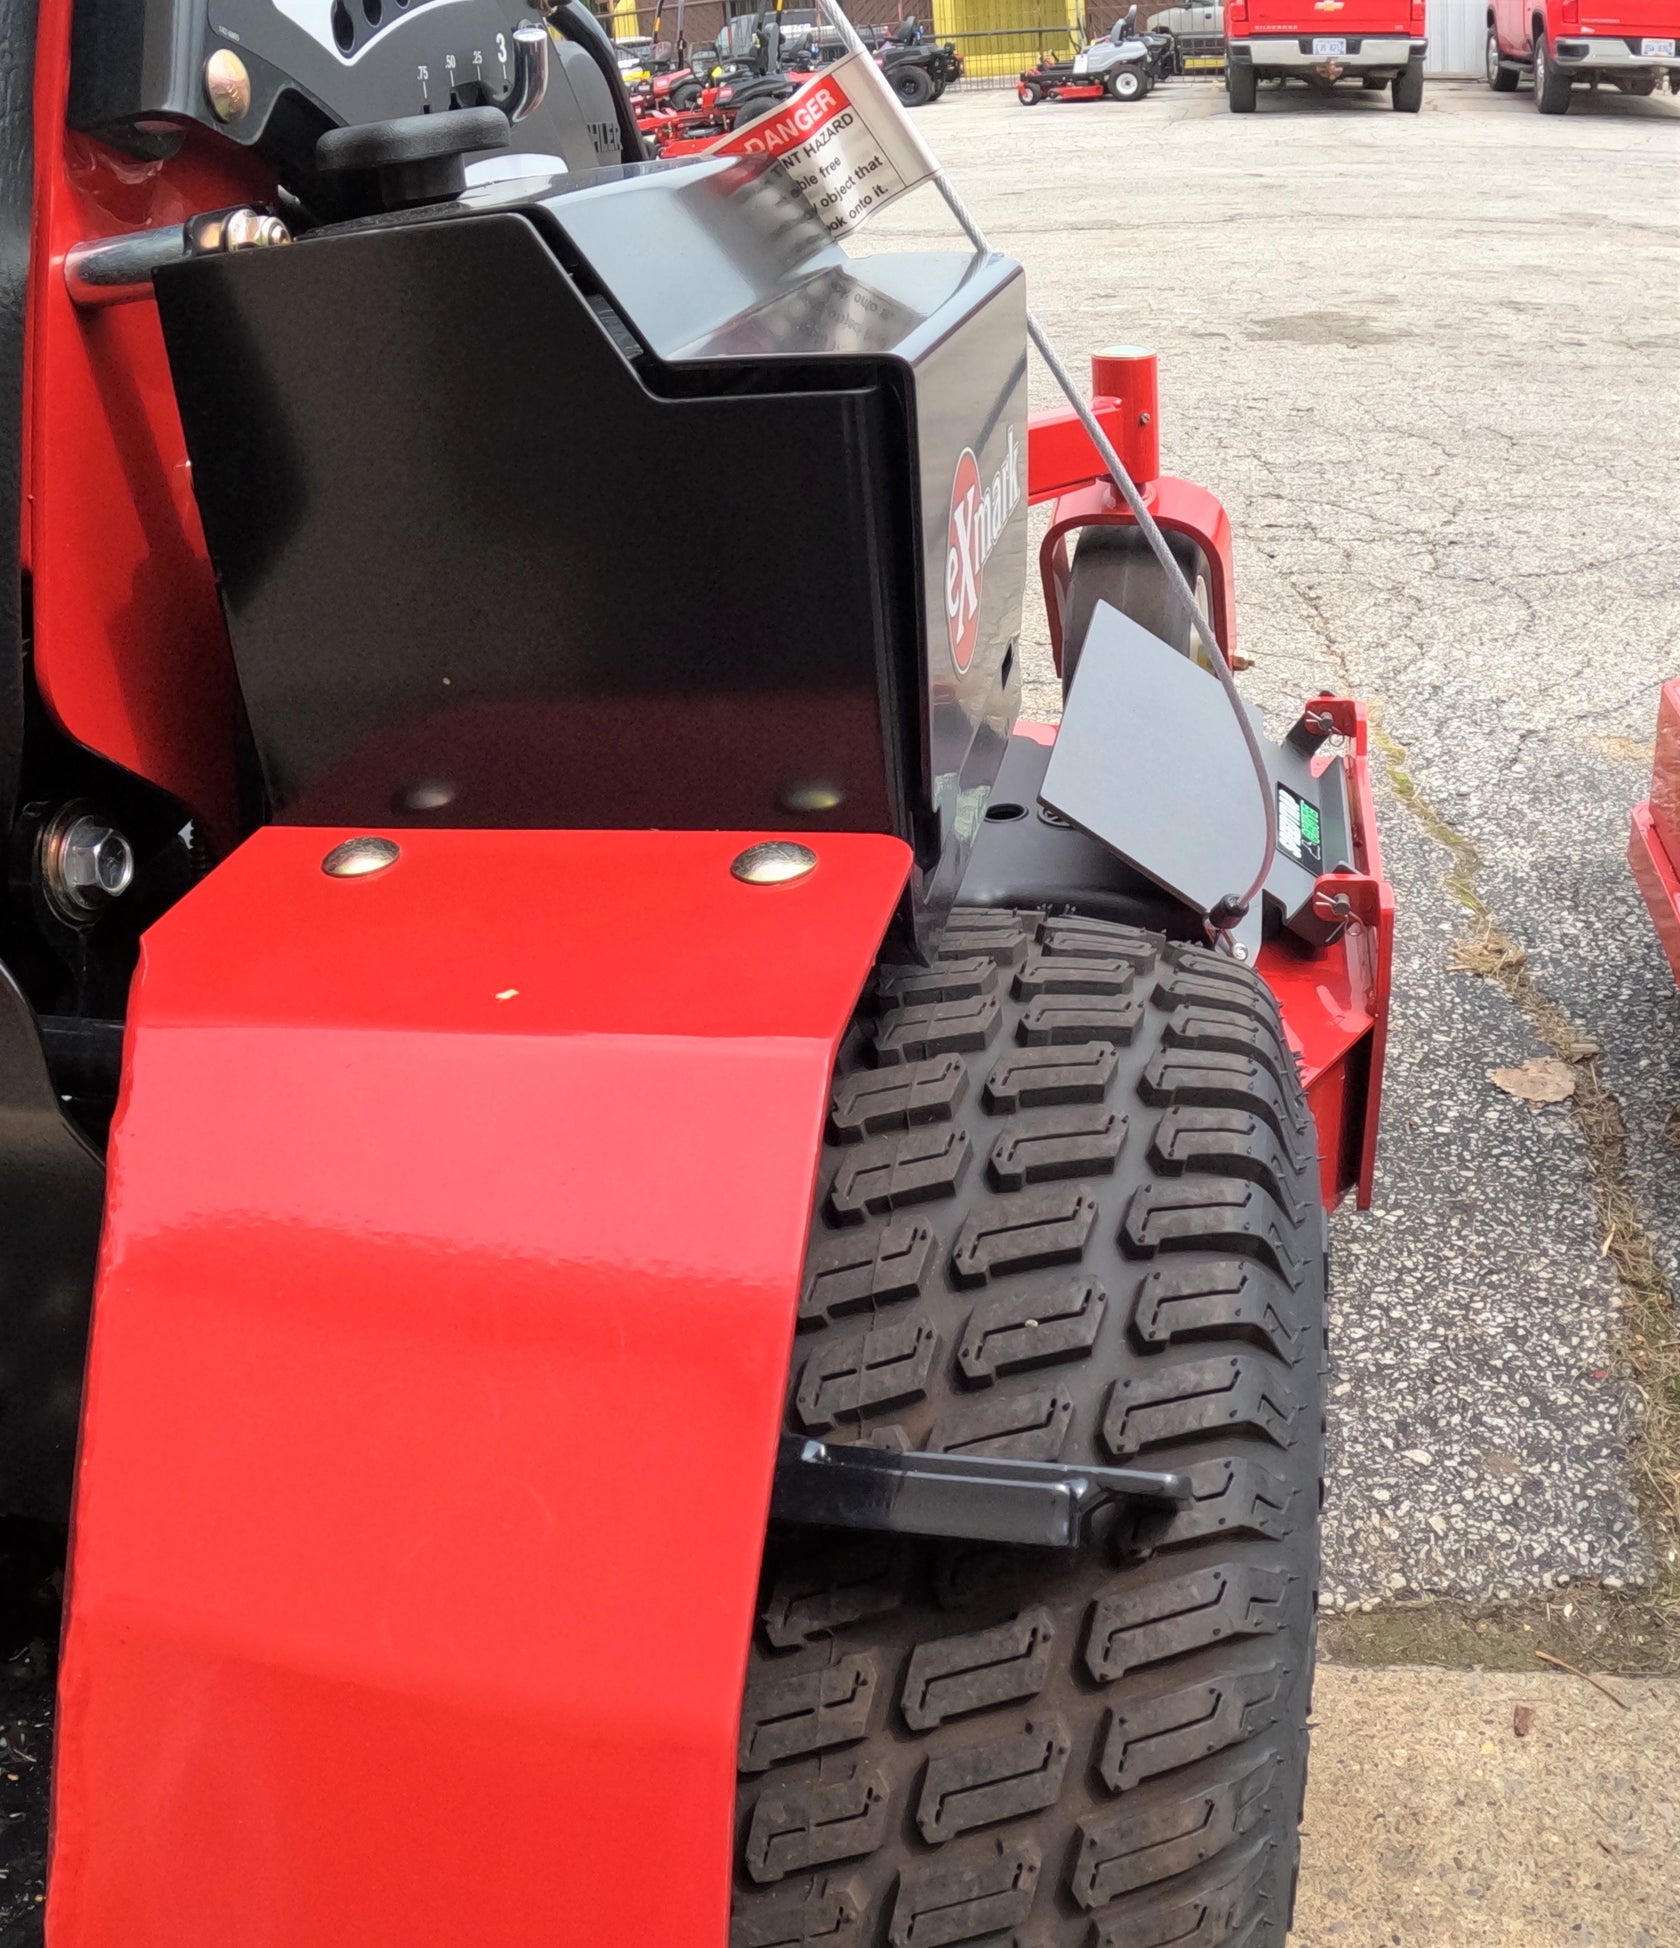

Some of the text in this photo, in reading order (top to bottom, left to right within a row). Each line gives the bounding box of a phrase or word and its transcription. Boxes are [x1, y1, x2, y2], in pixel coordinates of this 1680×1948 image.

[445, 54, 456, 69] .50
[472, 50, 483, 65] .25
[496, 32, 507, 63] 3
[417, 65, 429, 80] .75
[744, 88, 837, 155] DANGER
[803, 112, 854, 158] HAZARD
[819, 156, 842, 178] free
[820, 155, 883, 208] object that
[849, 193, 873, 219] onto
[872, 183, 888, 198] it.
